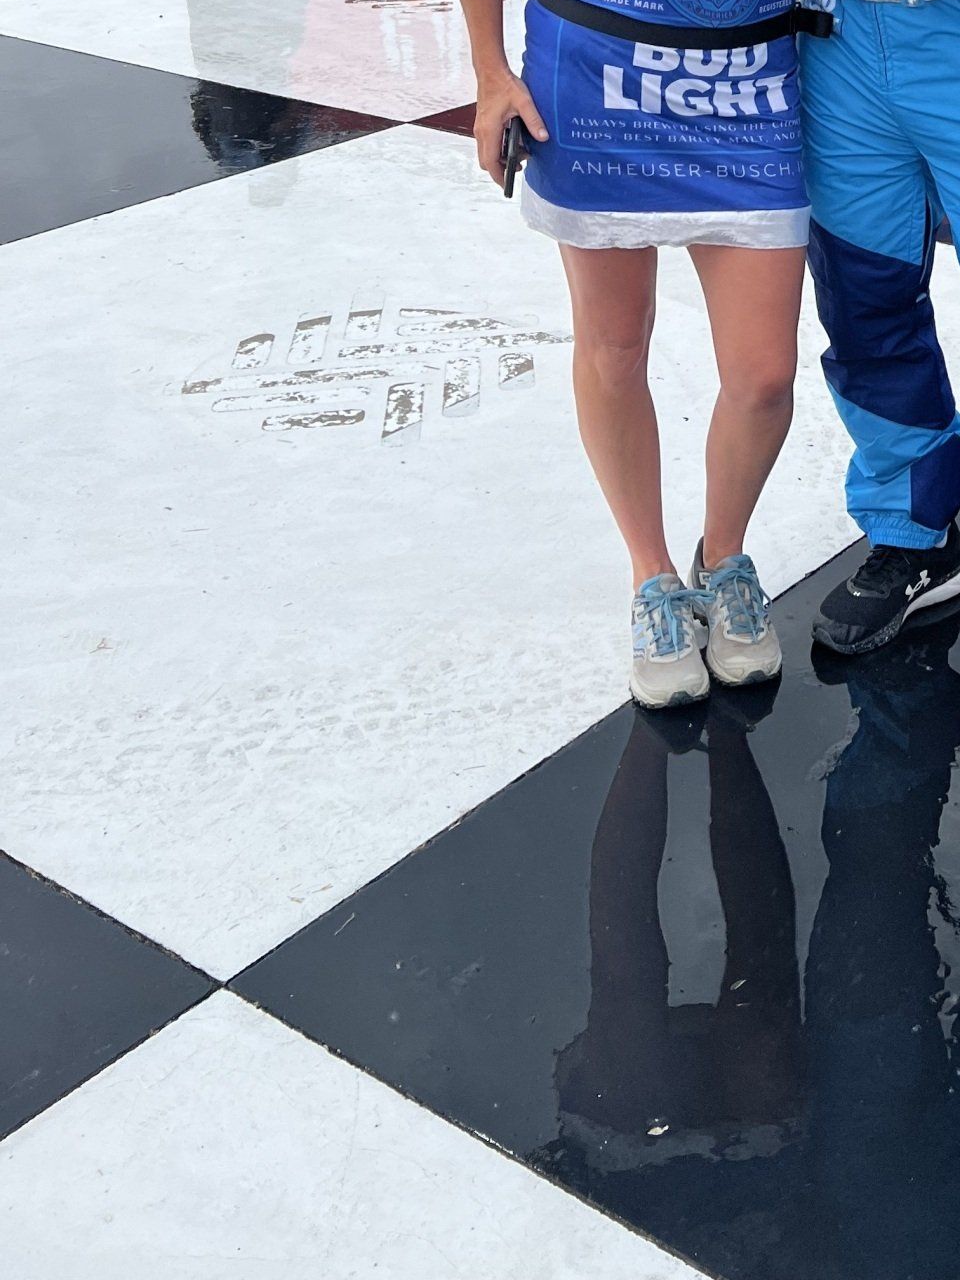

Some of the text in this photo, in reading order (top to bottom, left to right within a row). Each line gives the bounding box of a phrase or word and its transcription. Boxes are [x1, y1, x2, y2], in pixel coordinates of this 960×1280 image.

[633, 0, 664, 12] MARK
[633, 41, 768, 77] BUD
[603, 64, 789, 117] LIGHT
